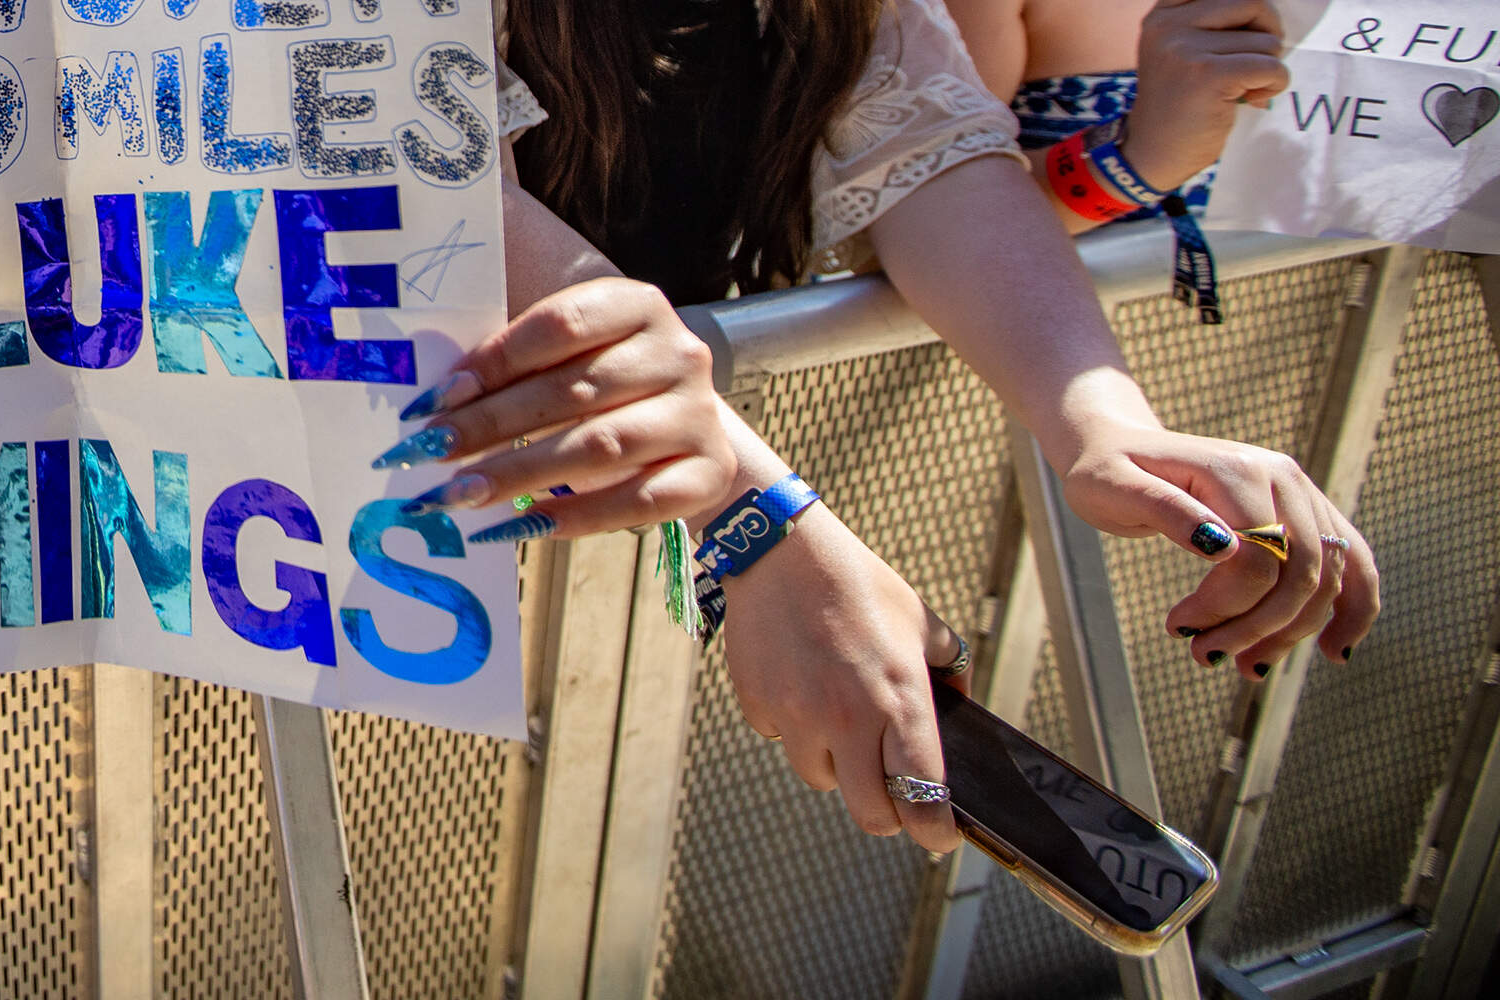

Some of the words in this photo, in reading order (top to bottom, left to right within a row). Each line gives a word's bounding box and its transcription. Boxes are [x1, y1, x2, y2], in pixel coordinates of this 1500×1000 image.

[1340, 17, 1385, 54] &
[1401, 22, 1500, 68] FU
[54, 31, 496, 187] MILES
[1290, 90, 1388, 140] WE
[713, 506, 770, 554] GA
